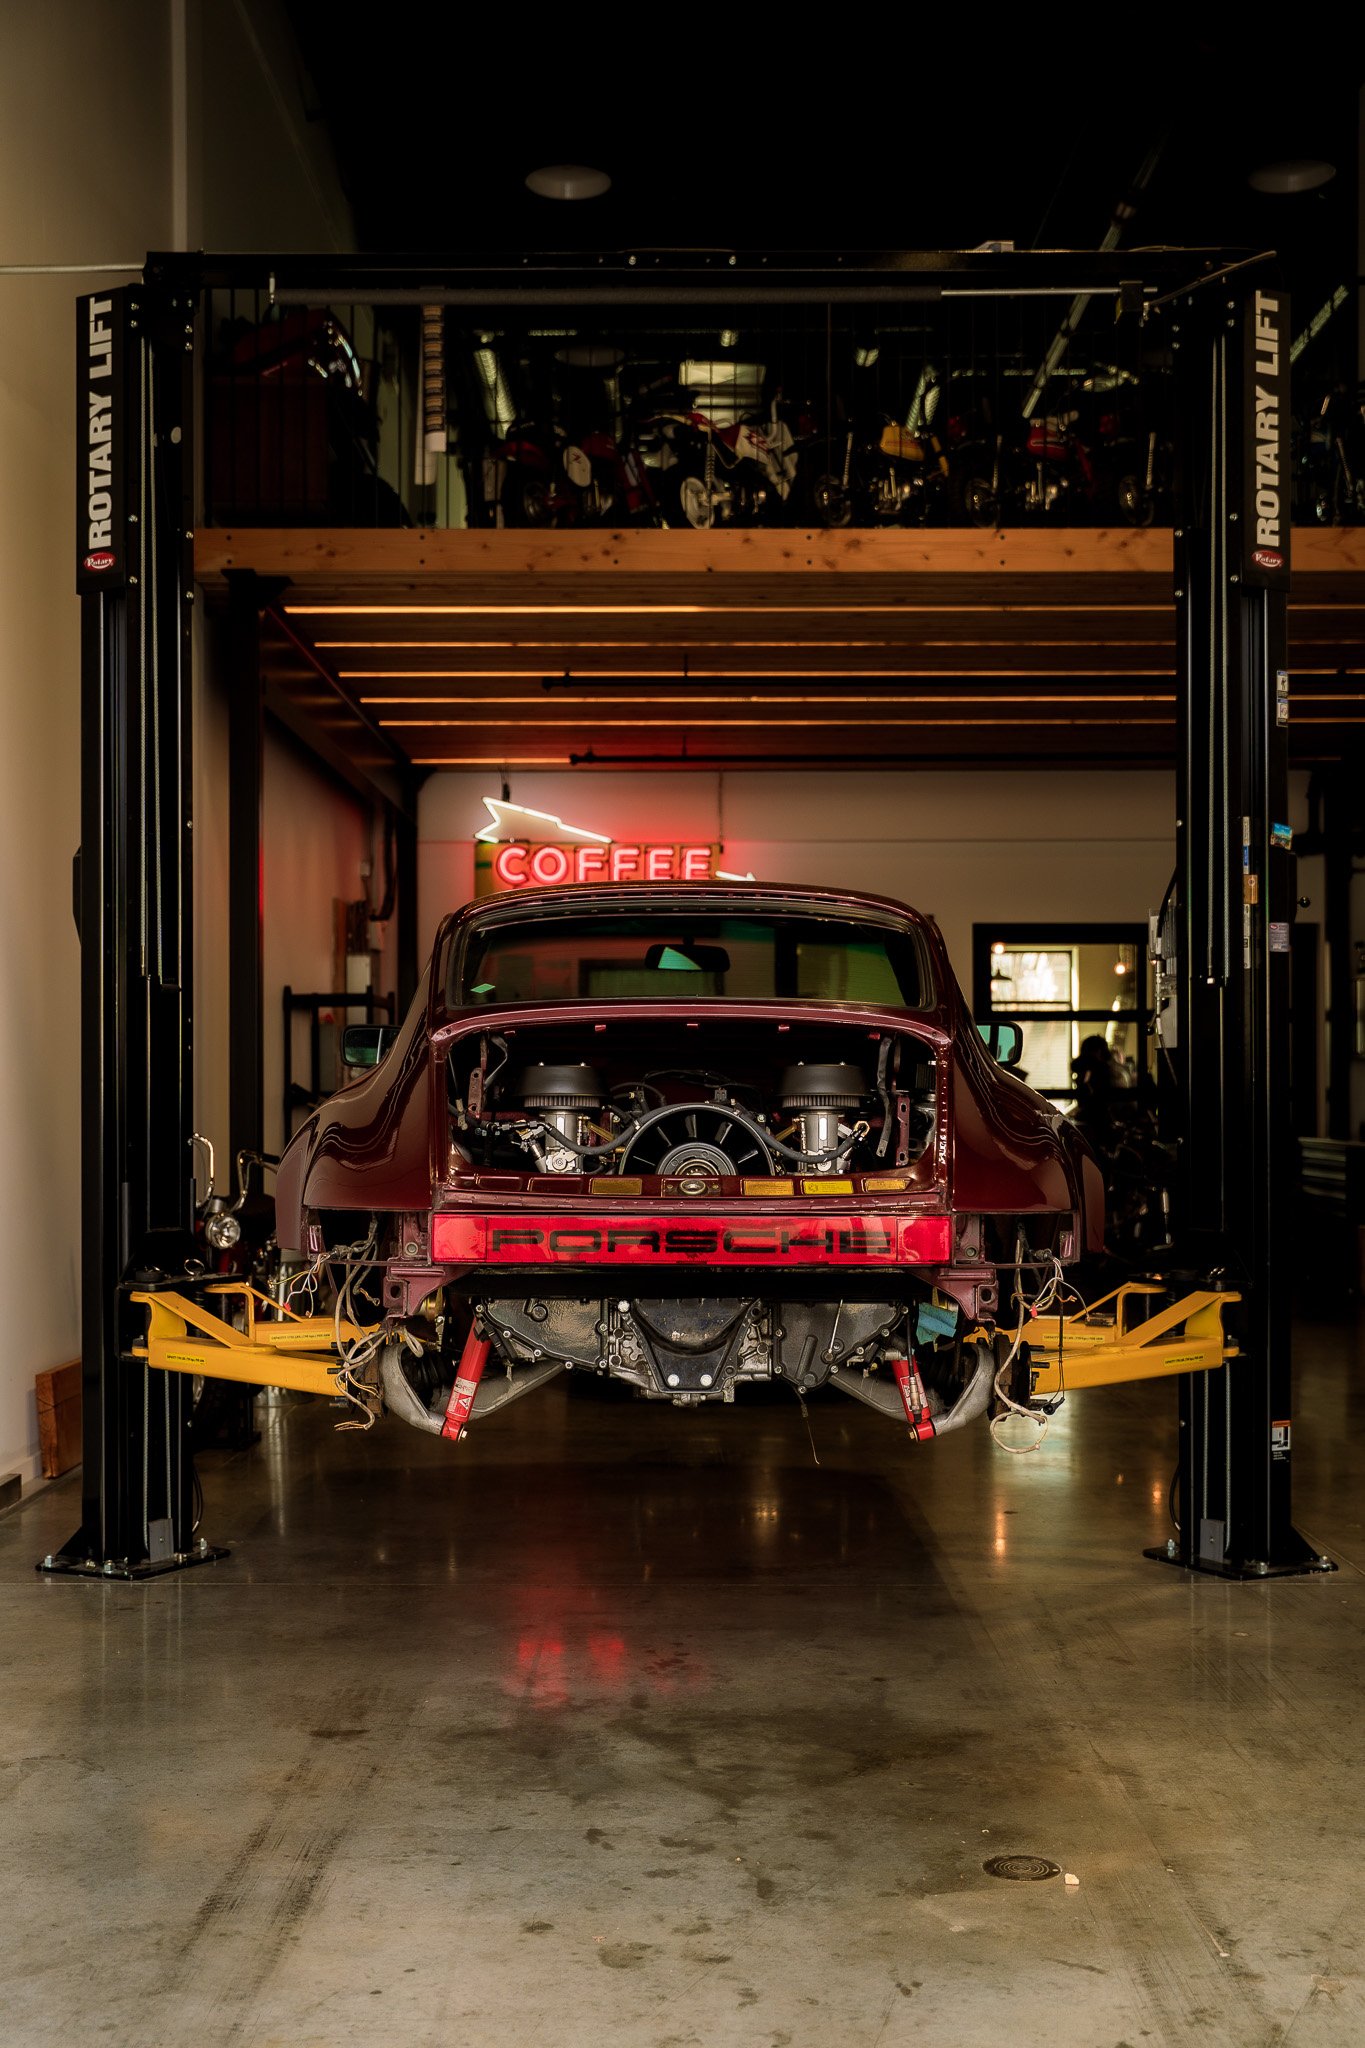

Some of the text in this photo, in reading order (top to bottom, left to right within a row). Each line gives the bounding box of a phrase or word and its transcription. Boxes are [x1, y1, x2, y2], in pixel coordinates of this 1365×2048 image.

[89, 297, 113, 550] ROTARY LIFT
[1255, 290, 1280, 547] ROTARY LIFT
[86, 557, 113, 569] Rotary
[1254, 553, 1282, 568] Rotary
[496, 846, 713, 884] COFFEE
[491, 1228, 891, 1254] PORSCHE
